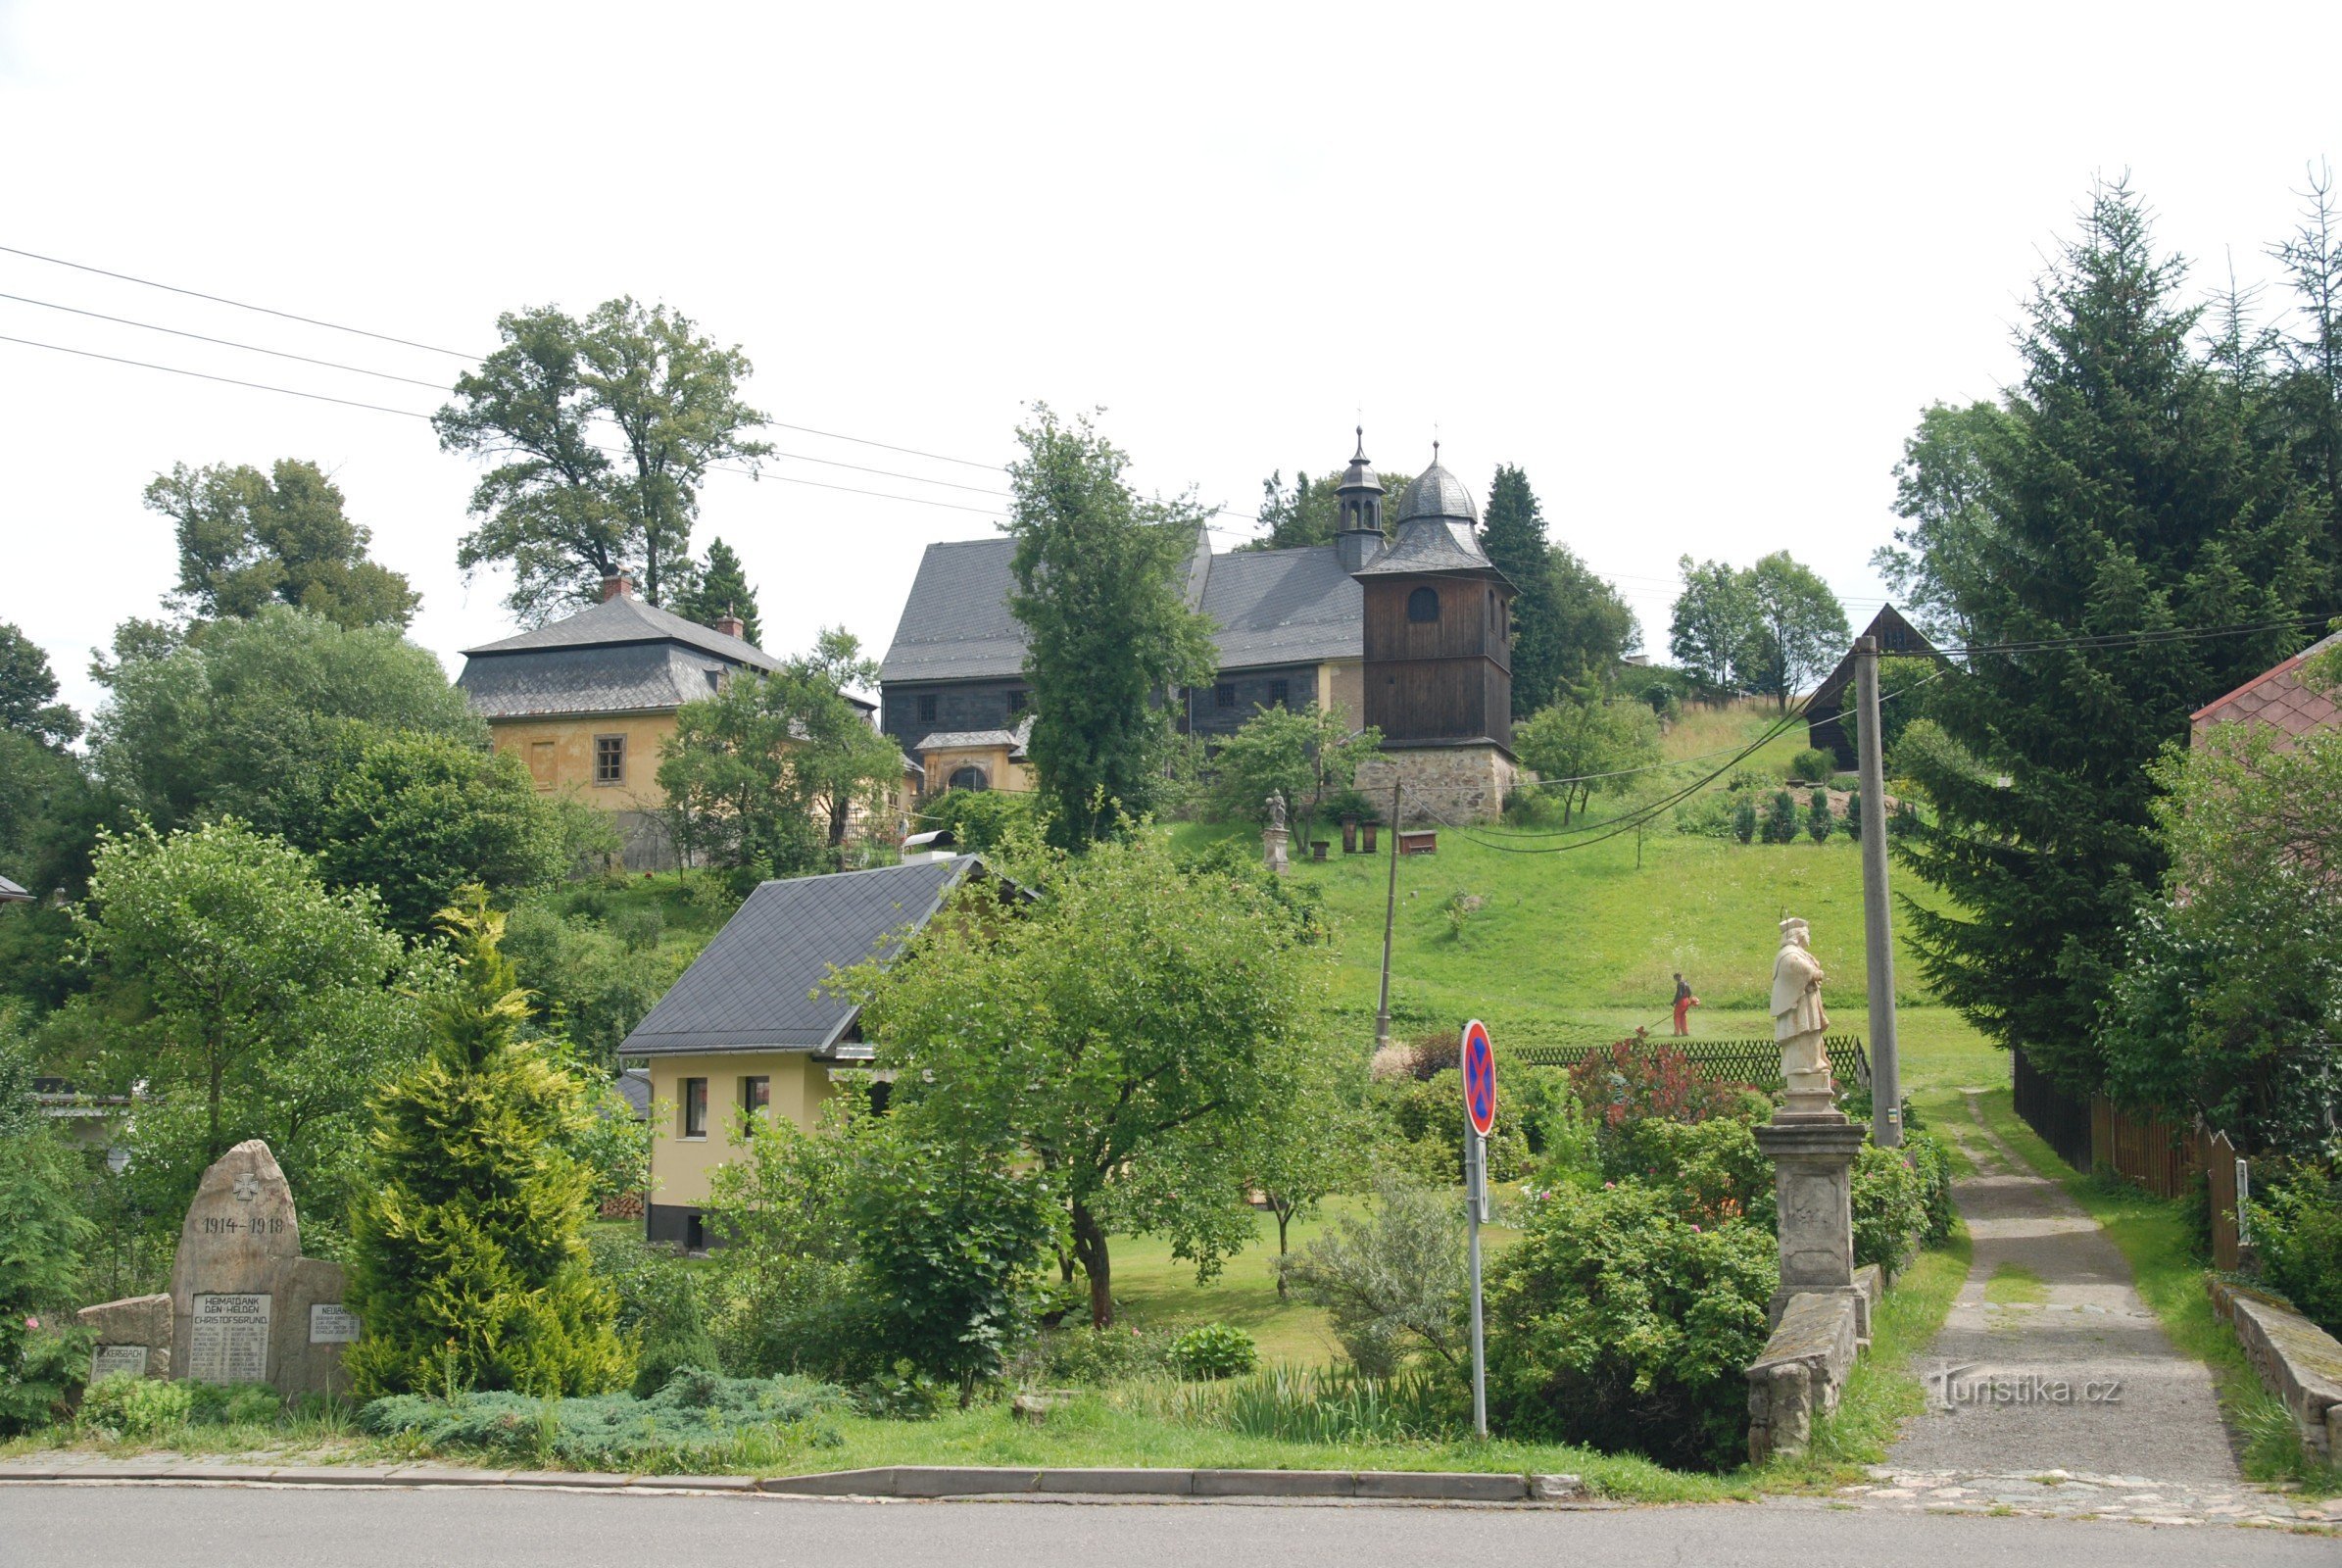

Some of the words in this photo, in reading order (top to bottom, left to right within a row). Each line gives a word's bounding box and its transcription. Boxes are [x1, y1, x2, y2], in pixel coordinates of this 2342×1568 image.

[202, 1217, 283, 1234] 1914-1918
[205, 1297, 260, 1305] HEIMATDANK
[204, 1305, 222, 1314] DEN
[226, 1305, 260, 1314] HELDEN
